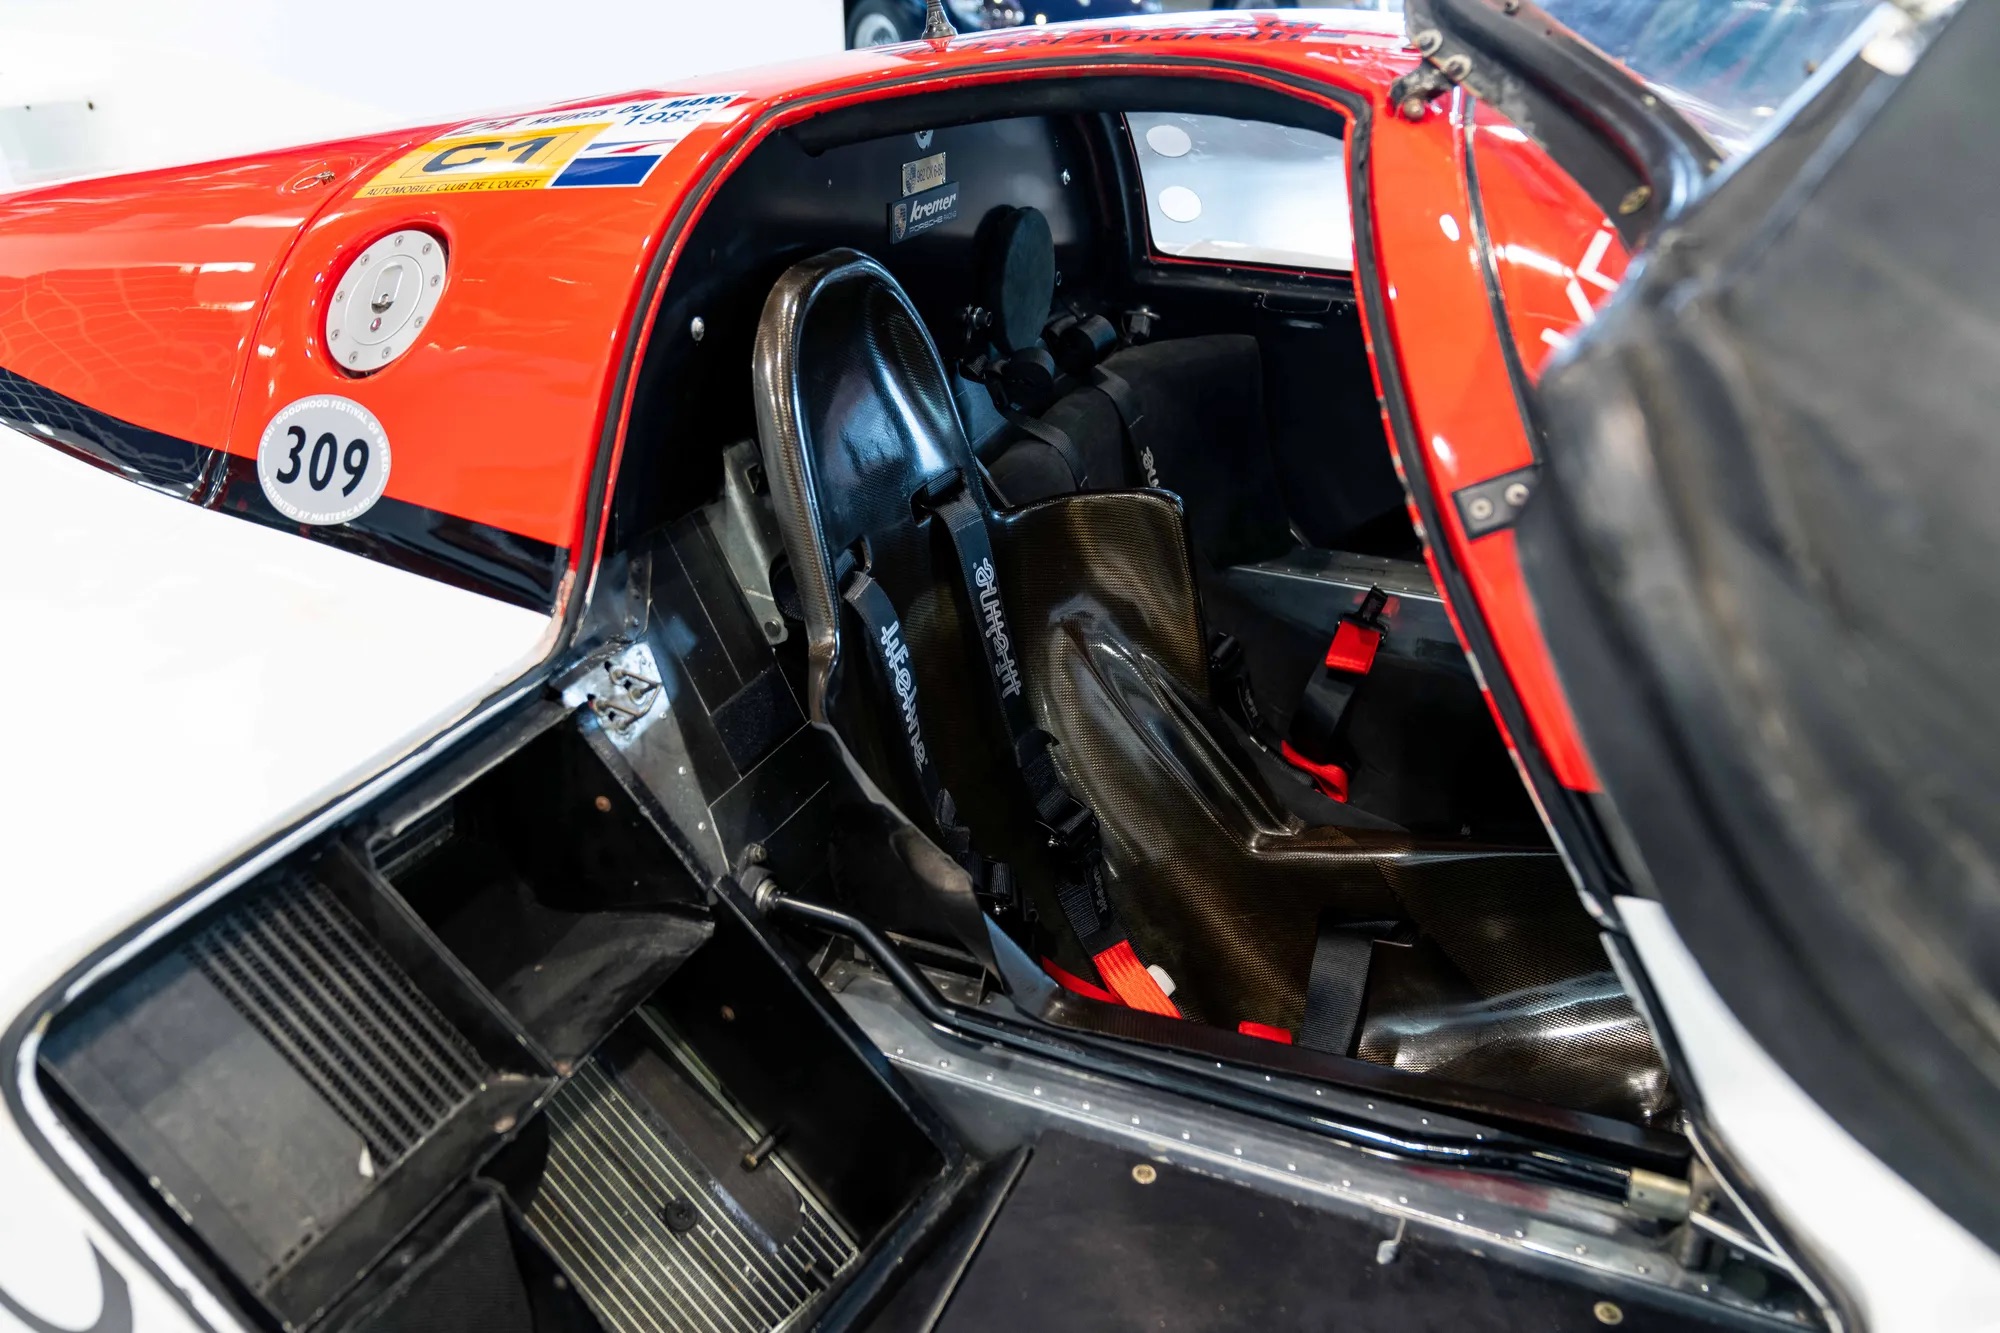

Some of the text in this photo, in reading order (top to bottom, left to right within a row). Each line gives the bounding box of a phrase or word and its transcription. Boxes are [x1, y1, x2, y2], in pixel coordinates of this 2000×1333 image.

[1076, 31, 1302, 44] Andretti
[616, 103, 656, 115] DU
[661, 94, 738, 109] MANS
[422, 136, 558, 173] C1
[366, 184, 438, 196] AUTOMOBILE
[436, 182, 467, 191] CLUB
[468, 181, 486, 190] DE
[910, 193, 957, 223] kremer
[910, 215, 943, 233] PORSCHE
[276, 399, 329, 425] GOODWOOD
[331, 400, 368, 425] FESTIVAL
[368, 421, 380, 435] OF
[376, 435, 389, 473] SPEED
[276, 425, 369, 498] 309
[263, 476, 371, 522] PRESENTED BY MASTERCARD
[974, 557, 1022, 699] lifeline
[881, 620, 928, 774] lifeline
